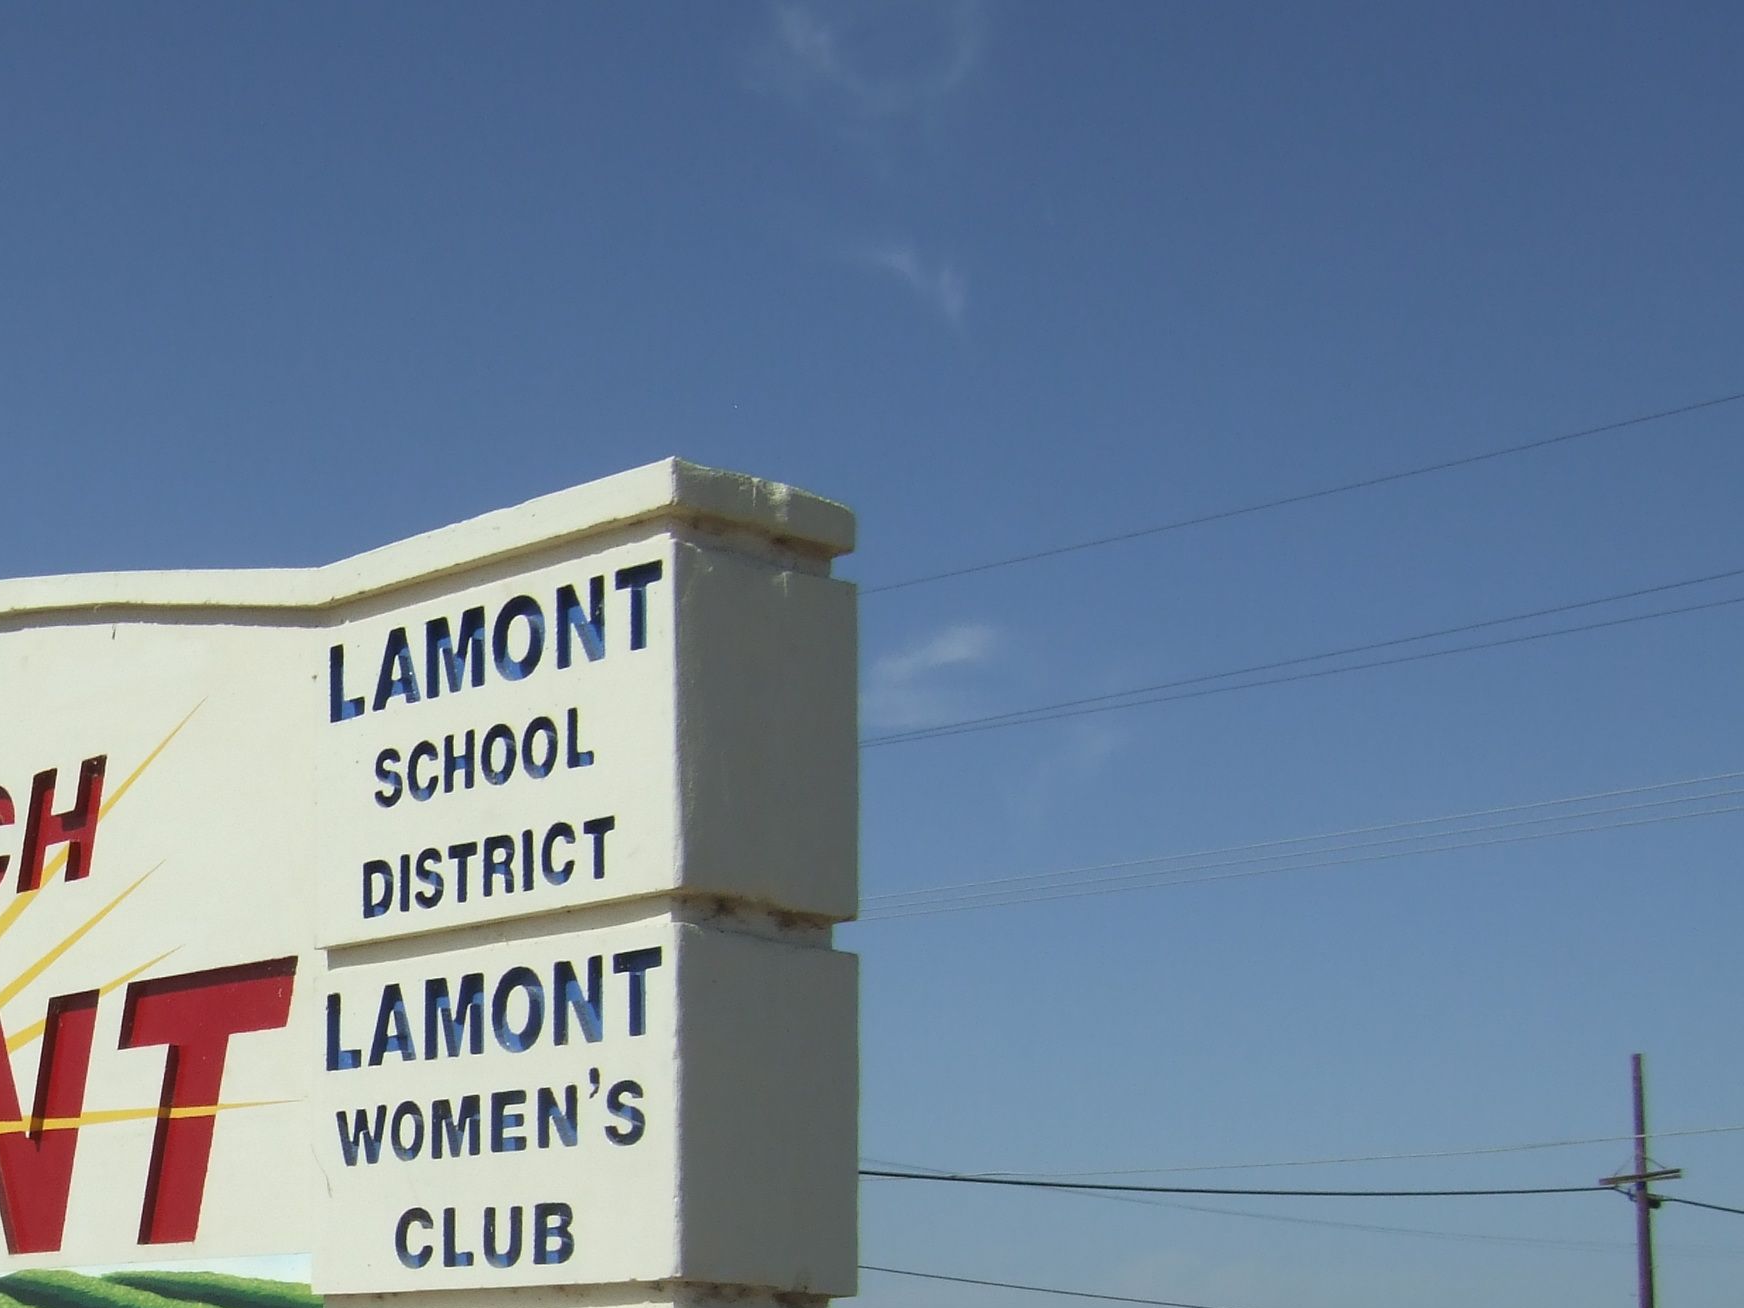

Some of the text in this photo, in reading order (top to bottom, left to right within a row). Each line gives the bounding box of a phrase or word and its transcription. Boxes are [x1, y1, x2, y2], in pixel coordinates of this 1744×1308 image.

[328, 560, 664, 722] LAMONT
[373, 708, 595, 808] SCHOOL
[362, 816, 616, 919] DISTRICT
[326, 946, 663, 1071] LAMONT
[336, 1068, 646, 1167] WOMEN'S
[395, 1202, 575, 1270] CLUB
